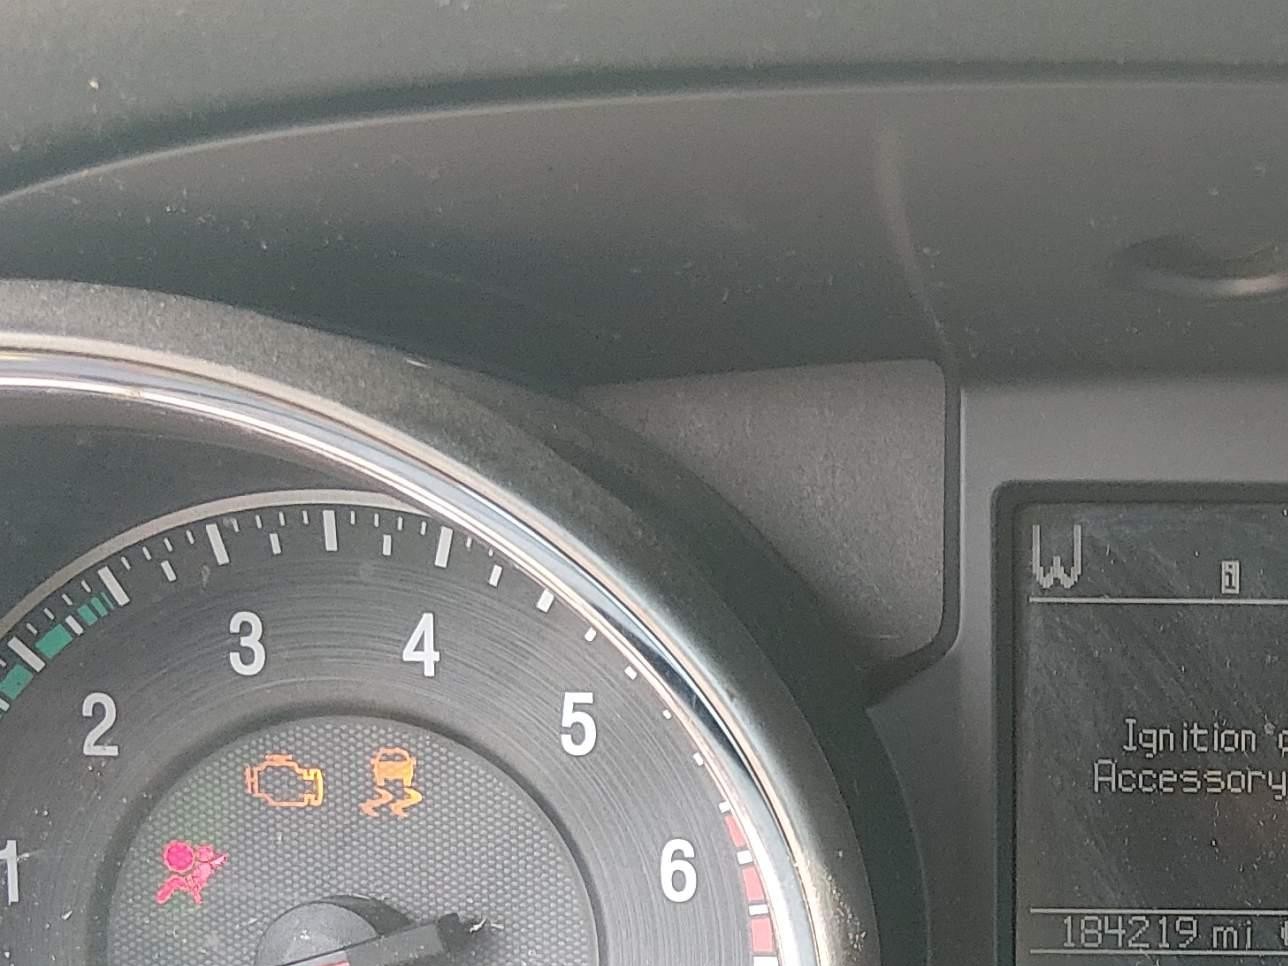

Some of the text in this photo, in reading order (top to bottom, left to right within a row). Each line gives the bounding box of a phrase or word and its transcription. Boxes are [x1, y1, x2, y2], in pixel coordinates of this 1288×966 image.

[1032, 524, 1082, 589] W
[229, 611, 266, 676] 3
[402, 612, 440, 677] 4
[81, 692, 120, 757] 2
[560, 692, 598, 757] 5
[1122, 718, 1257, 758] Ignition
[1093, 760, 1288, 800] Accessory
[660, 838, 697, 904] 6
[1062, 915, 1199, 949] 184219
[1211, 920, 1253, 950] mi
